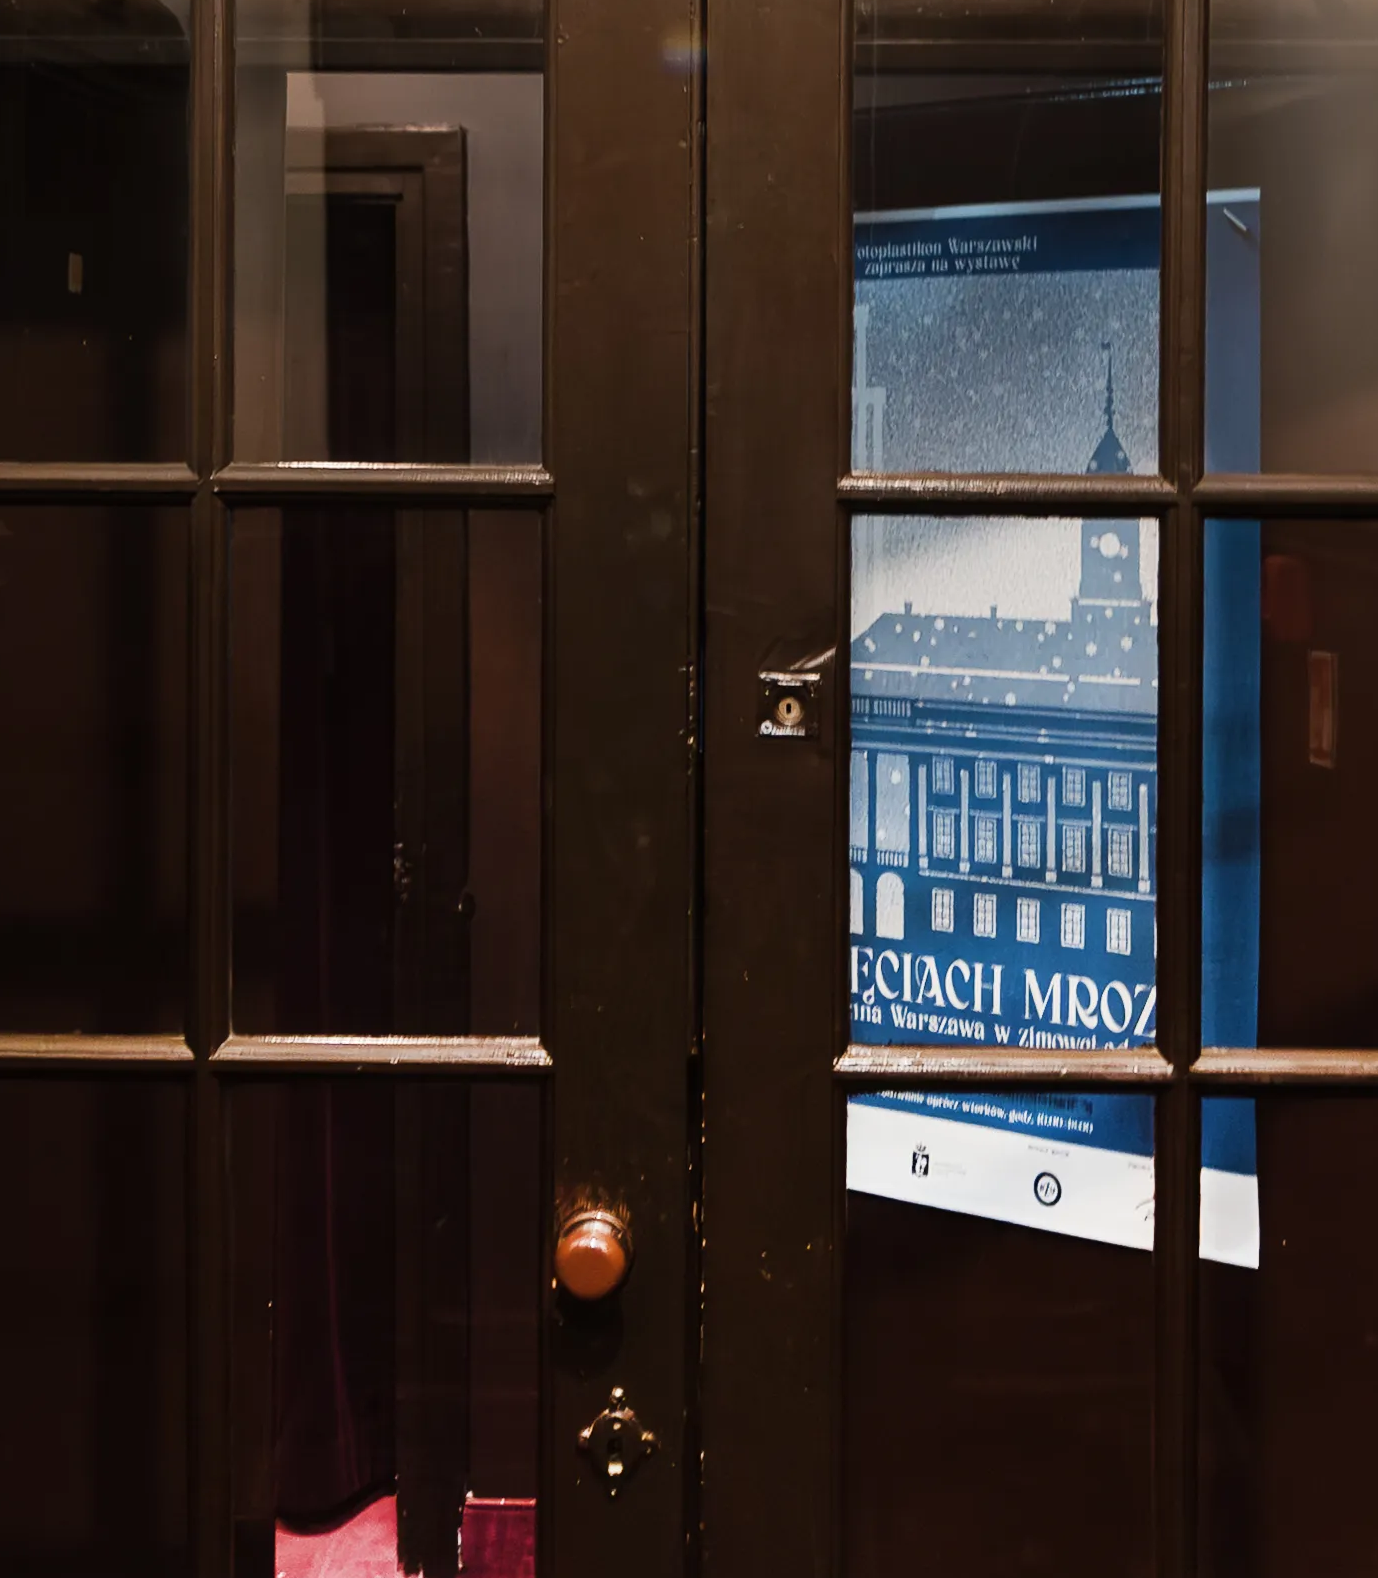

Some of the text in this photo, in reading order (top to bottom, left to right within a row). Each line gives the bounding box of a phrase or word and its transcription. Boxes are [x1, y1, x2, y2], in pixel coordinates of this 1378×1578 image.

[856, 235, 1037, 261] otoplastikon Warszawski
[864, 259, 925, 277] zaprasza
[931, 257, 949, 273] na
[890, 1002, 985, 1041] Warszawa
[994, 1022, 1011, 1045] w
